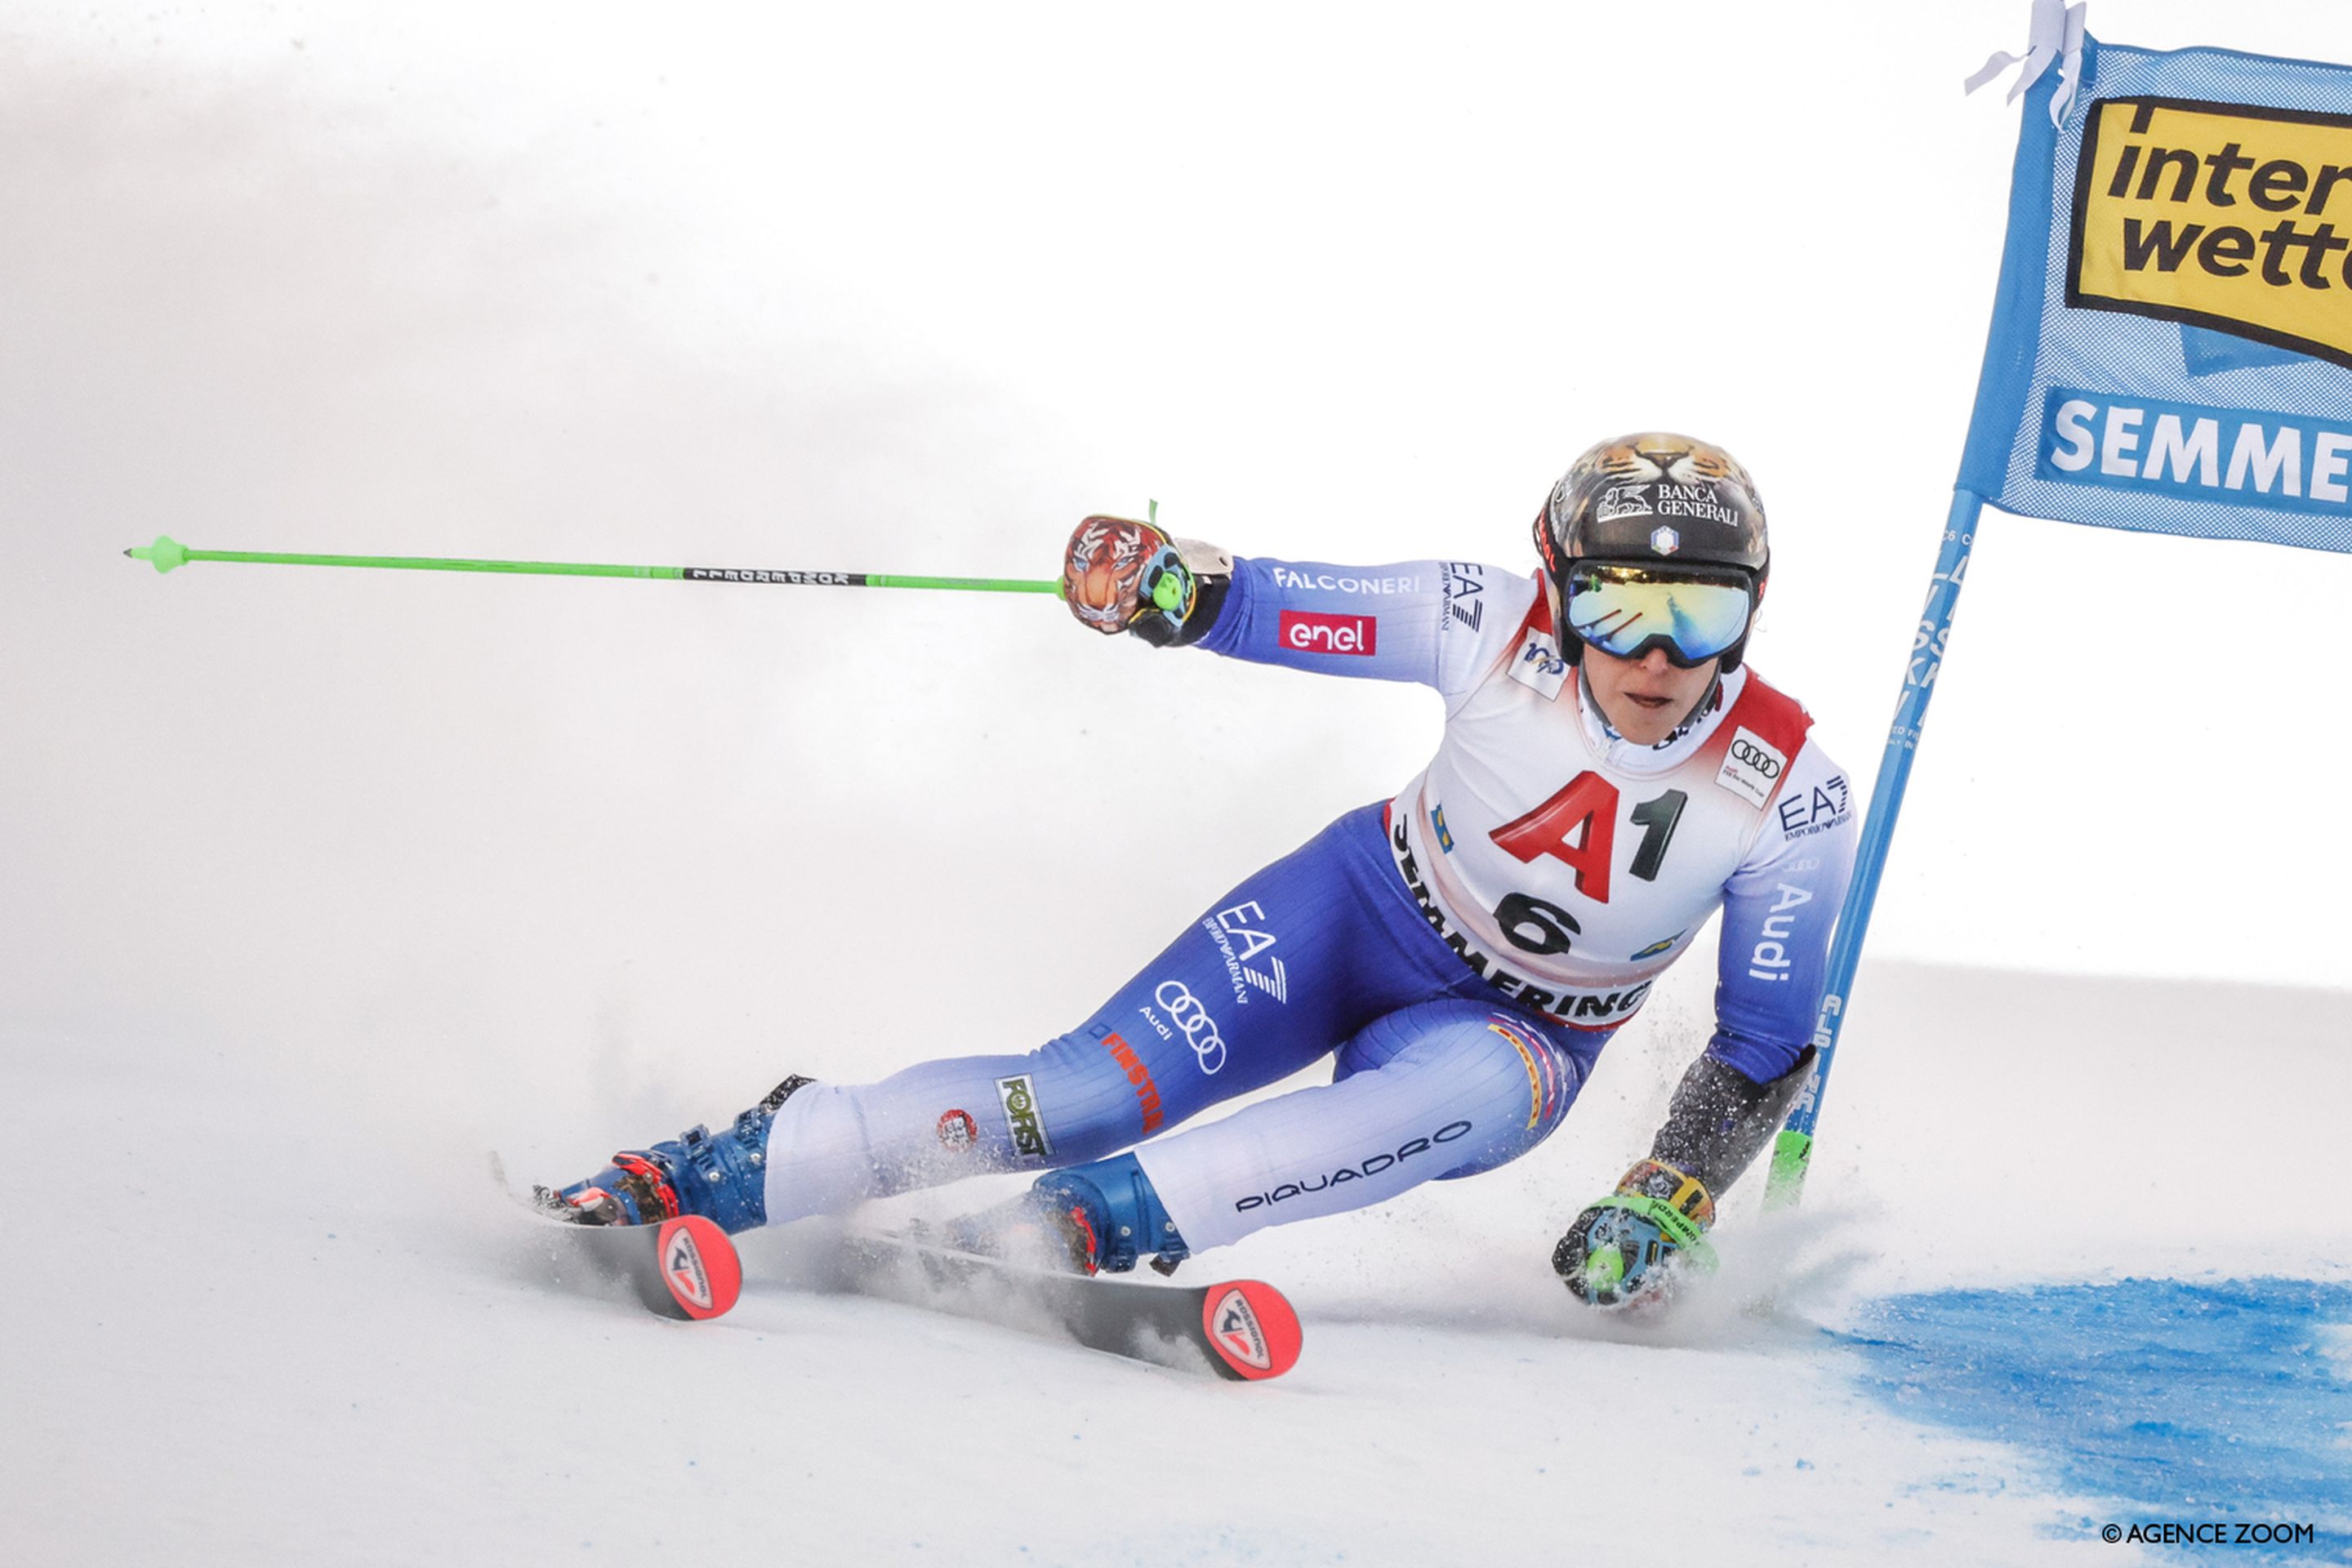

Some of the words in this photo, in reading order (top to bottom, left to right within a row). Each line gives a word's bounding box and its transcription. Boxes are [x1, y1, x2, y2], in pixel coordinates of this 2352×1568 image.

[2123, 217, 2352, 291] wett
[2050, 399, 2352, 503] SEMME
[1657, 500, 1739, 528] GENERALI
[1658, 484, 1718, 505] BANCA
[693, 568, 850, 586] KOMPERDELL
[1273, 567, 1420, 595] FALCONERI
[1449, 562, 1484, 633] EA7
[1290, 620, 1365, 652] enel
[1489, 770, 1688, 904] A1
[1779, 775, 1849, 832] EA7
[1217, 900, 1287, 1004] EA7
[1493, 892, 1582, 956] 6
[1748, 882, 1813, 981] Audi
[1139, 1005, 1174, 1041] Audi
[1002, 1078, 1047, 1156] FORST
[1236, 1120, 1472, 1213] PIQUADRO
